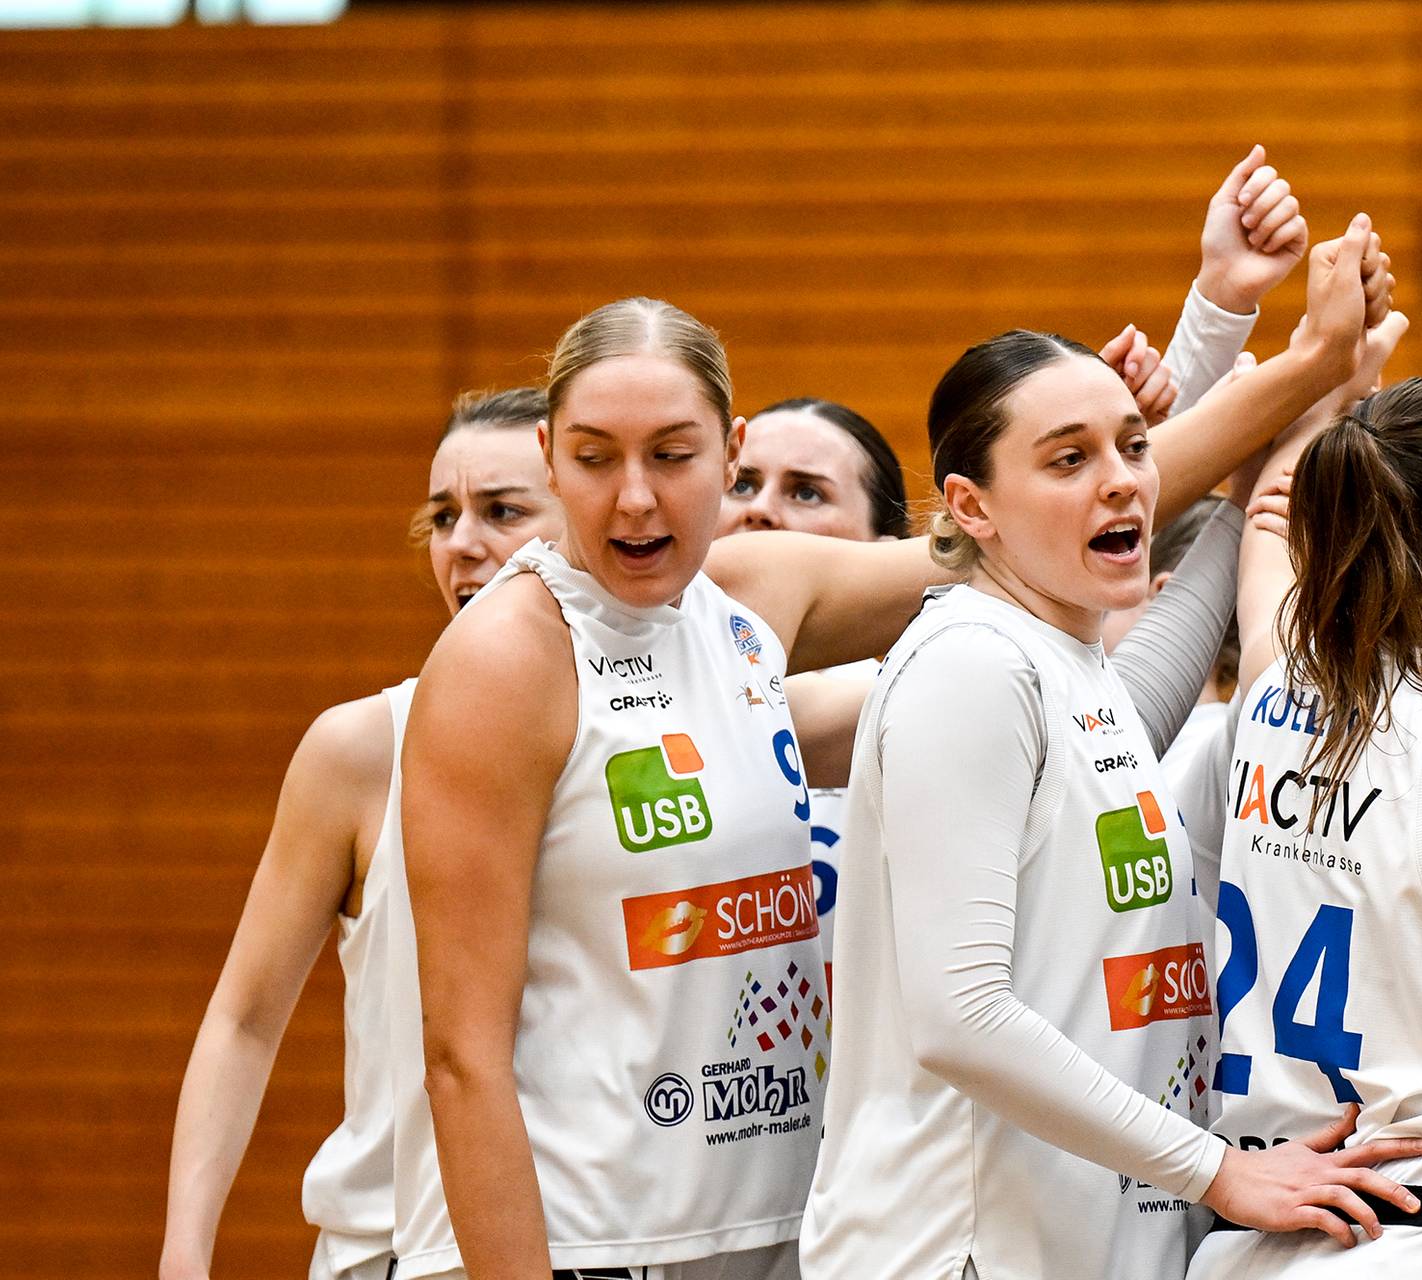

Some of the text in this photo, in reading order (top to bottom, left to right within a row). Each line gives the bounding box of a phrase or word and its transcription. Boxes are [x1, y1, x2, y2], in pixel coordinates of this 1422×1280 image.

[588, 654, 653, 677] VICTIV
[621, 794, 707, 844] USB
[1226, 758, 1383, 842] IACTIV
[1109, 855, 1170, 905] USB
[1250, 834, 1363, 876] Krankenkasse
[716, 873, 816, 940] SCHÖN
[1212, 880, 1366, 1104] 24
[701, 1056, 751, 1077] GERHARD
[705, 1112, 812, 1146] www.mohr-maler.de
